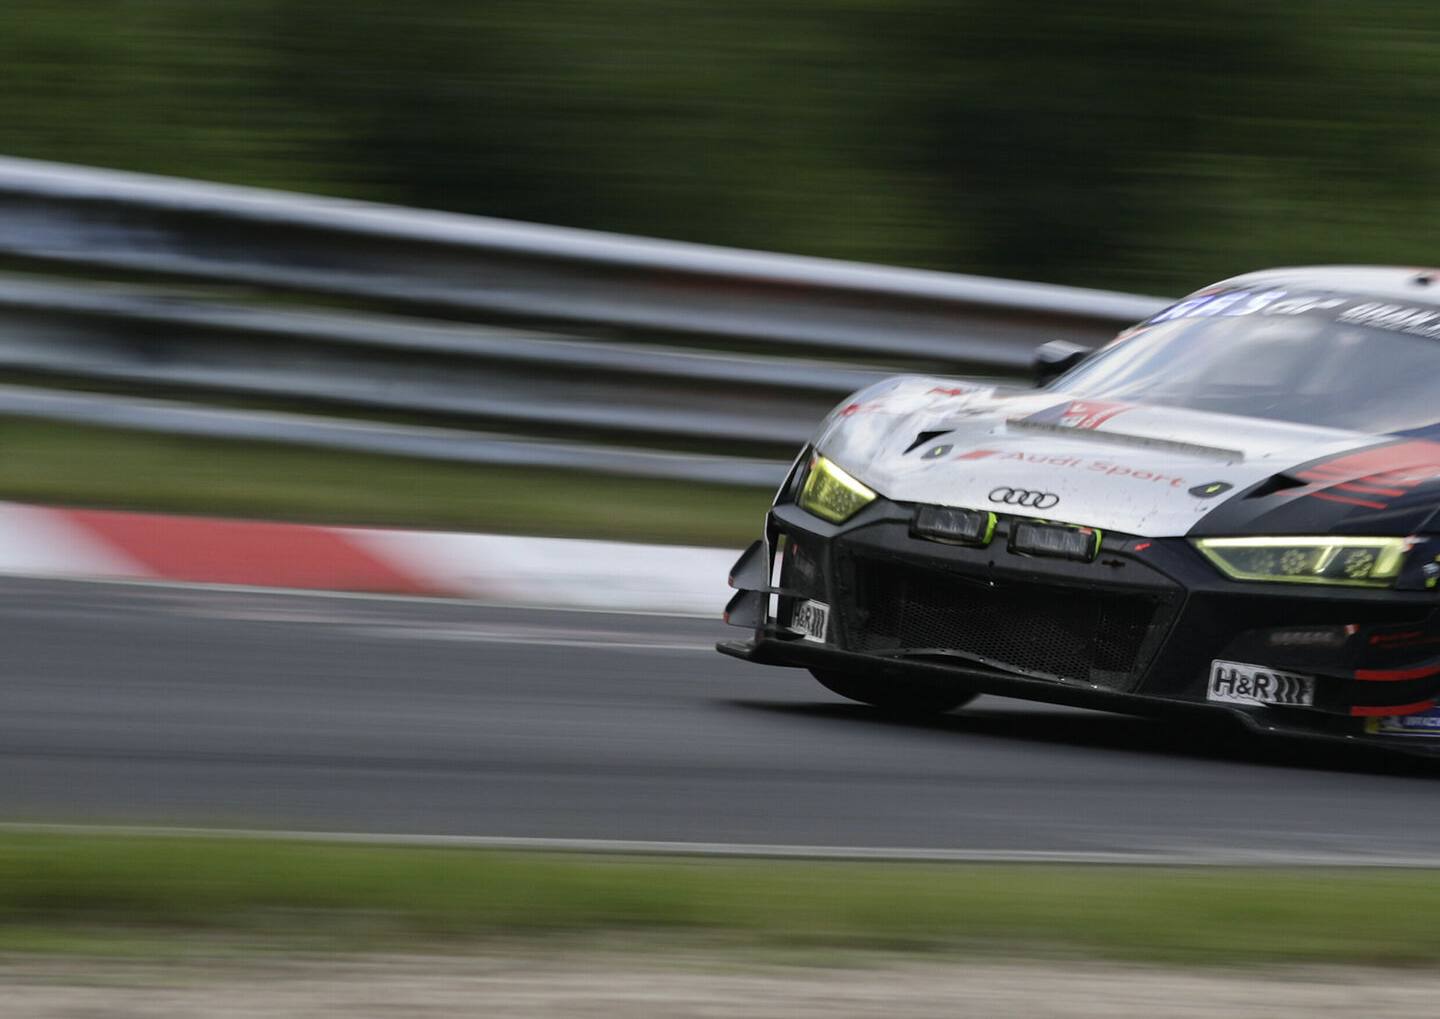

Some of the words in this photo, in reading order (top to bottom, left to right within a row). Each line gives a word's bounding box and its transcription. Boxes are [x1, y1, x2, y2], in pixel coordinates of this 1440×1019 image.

[1000, 452, 1084, 467] Audi
[1087, 461, 1187, 488] Sport
[1213, 668, 1271, 700] H&R
